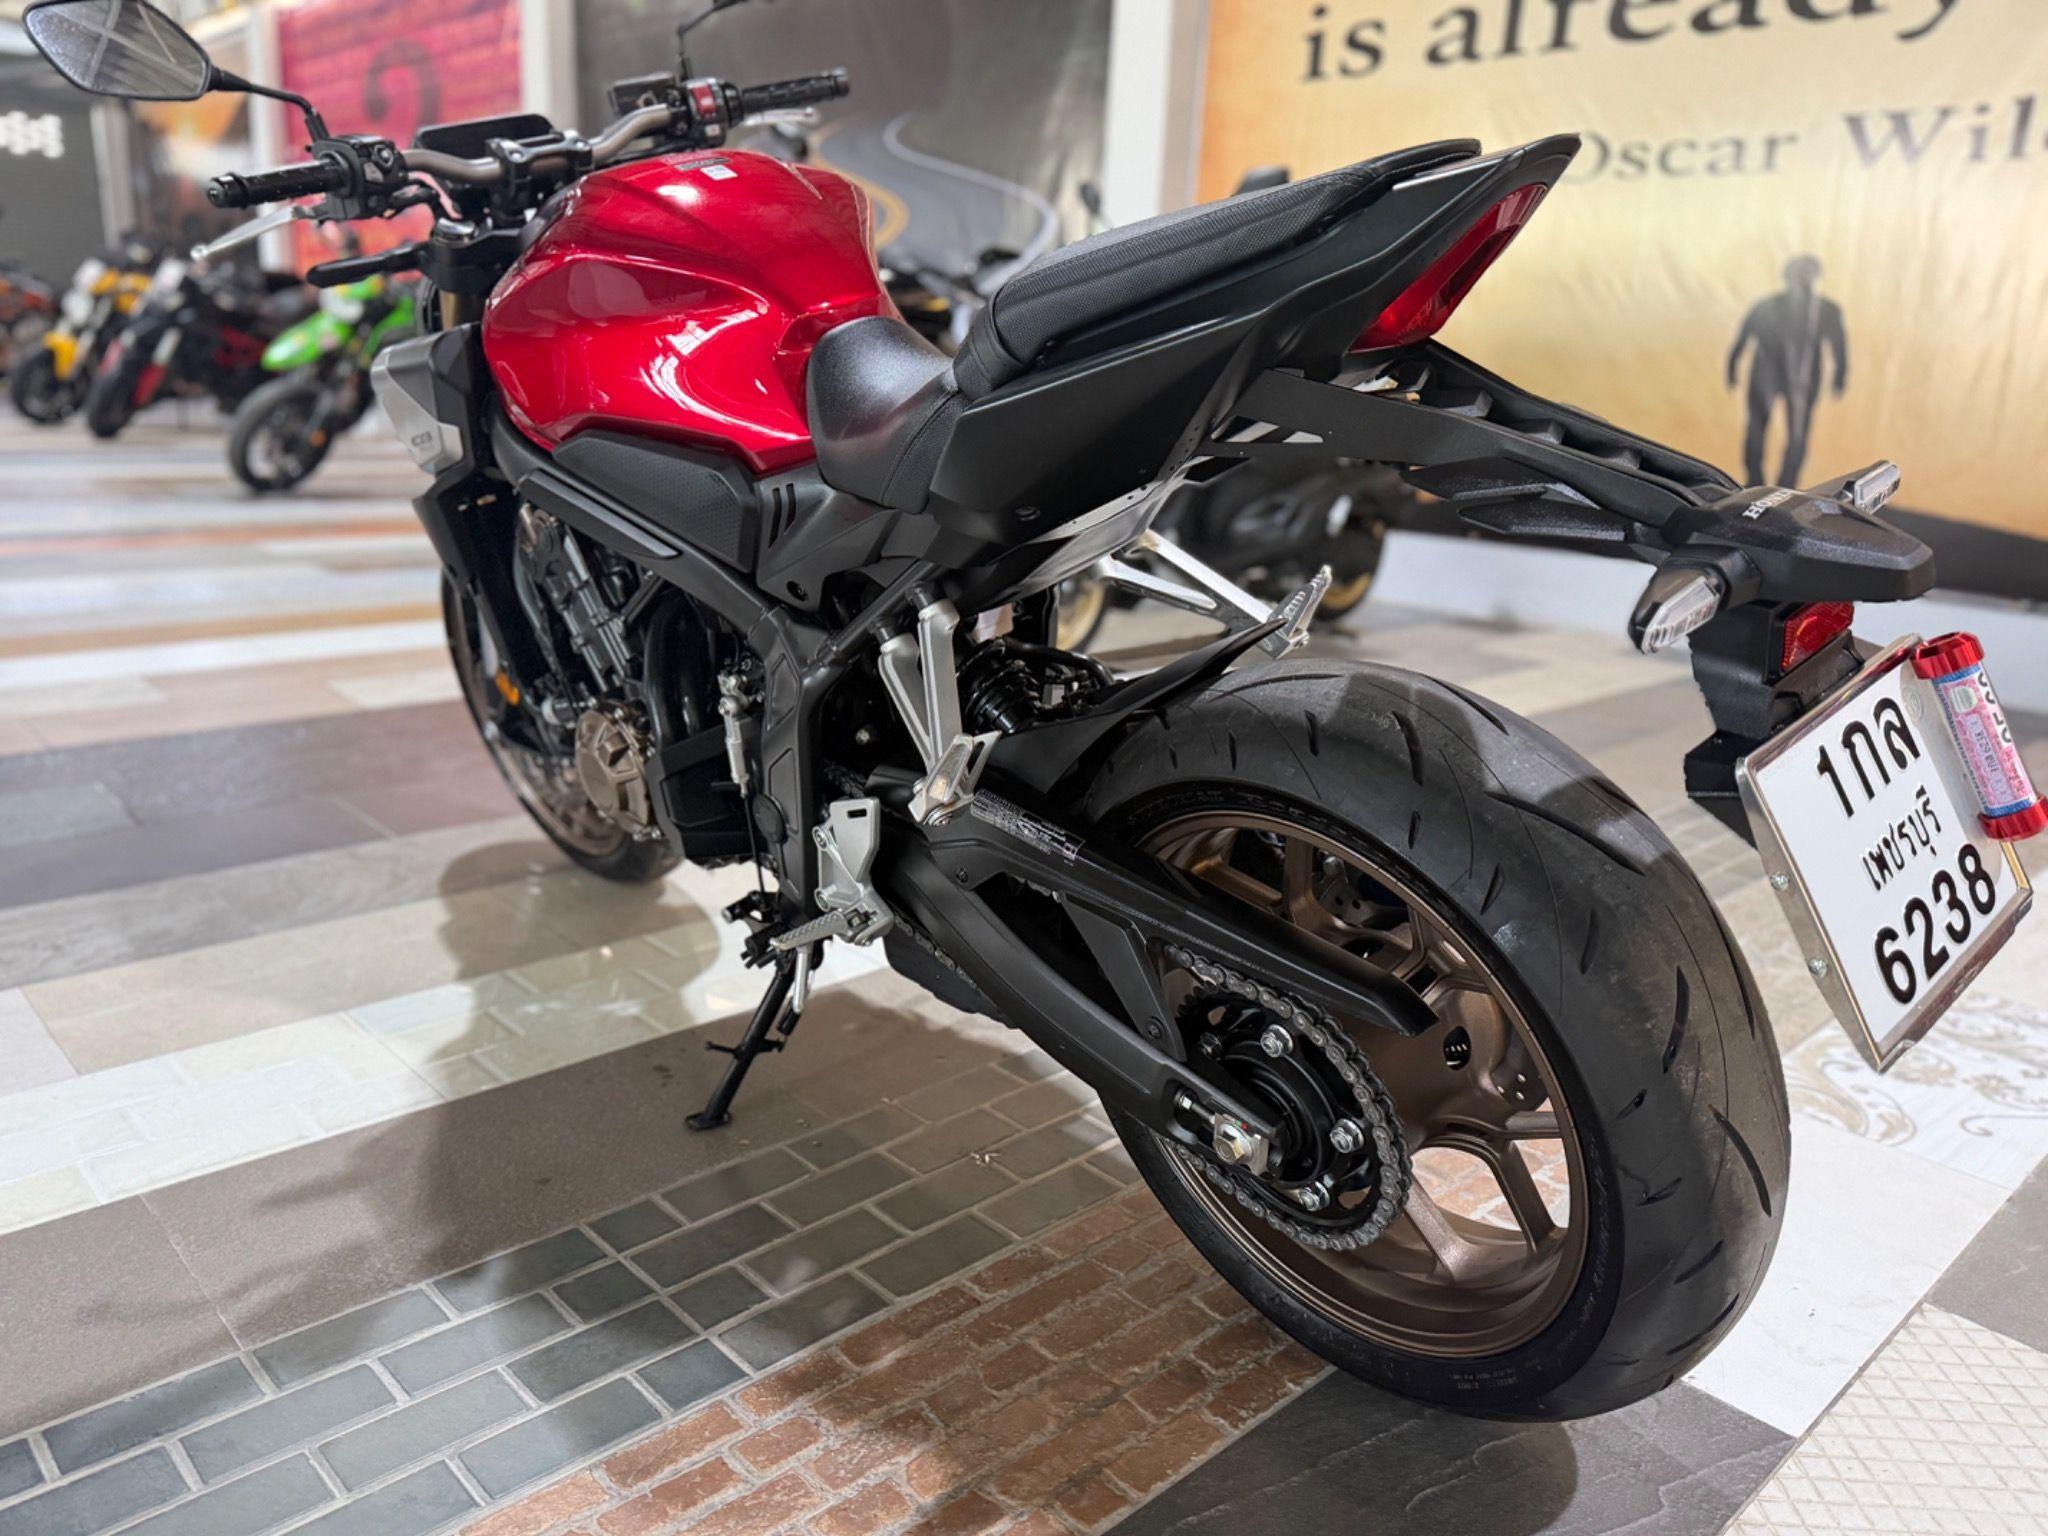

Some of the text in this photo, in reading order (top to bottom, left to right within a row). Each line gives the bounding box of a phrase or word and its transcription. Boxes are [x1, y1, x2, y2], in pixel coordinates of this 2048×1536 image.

[1302, 0, 1962, 81] is alre
[1843, 96, 2048, 168] Wil
[1816, 698, 1920, 818] 1กล
[1863, 785, 1940, 891] เพชรบุรี
[1874, 843, 1997, 1005] 6238
